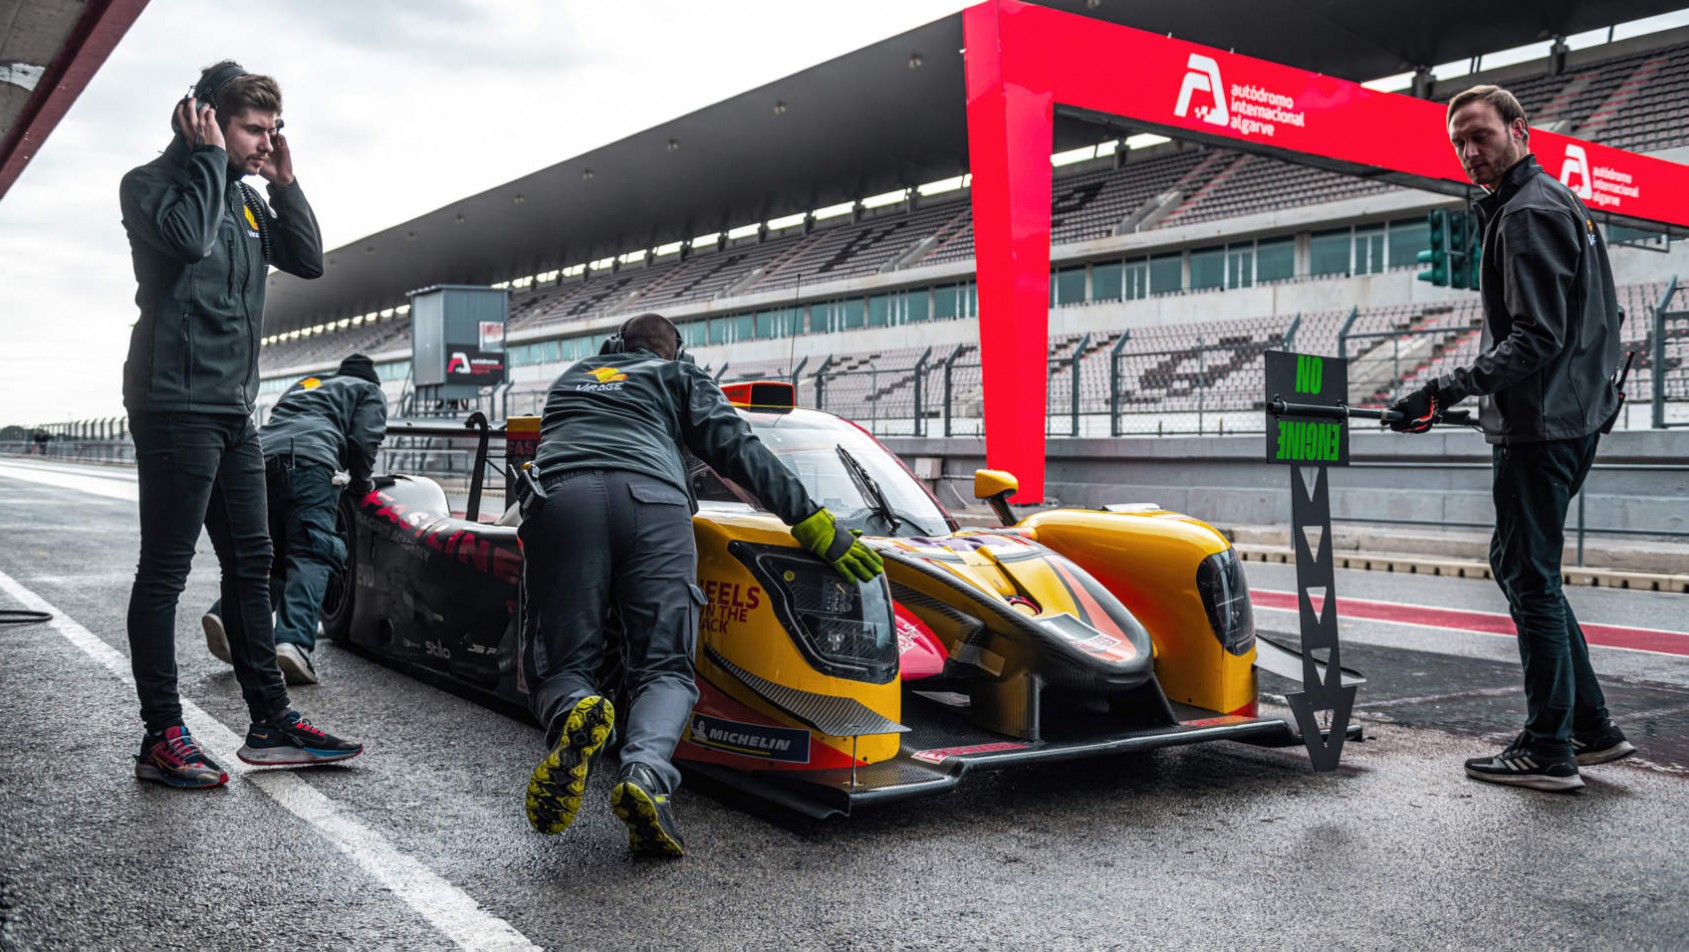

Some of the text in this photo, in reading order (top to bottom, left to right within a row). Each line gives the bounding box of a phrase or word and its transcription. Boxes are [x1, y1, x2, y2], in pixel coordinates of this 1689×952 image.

[1231, 84, 1294, 109] autódromo
[1231, 97, 1305, 128] internacional
[1230, 115, 1275, 137] algarve
[1276, 420, 1340, 461] ENGINE
[701, 579, 760, 610] EELS
[719, 605, 749, 623] THE
[709, 728, 792, 751] MICHELIN
